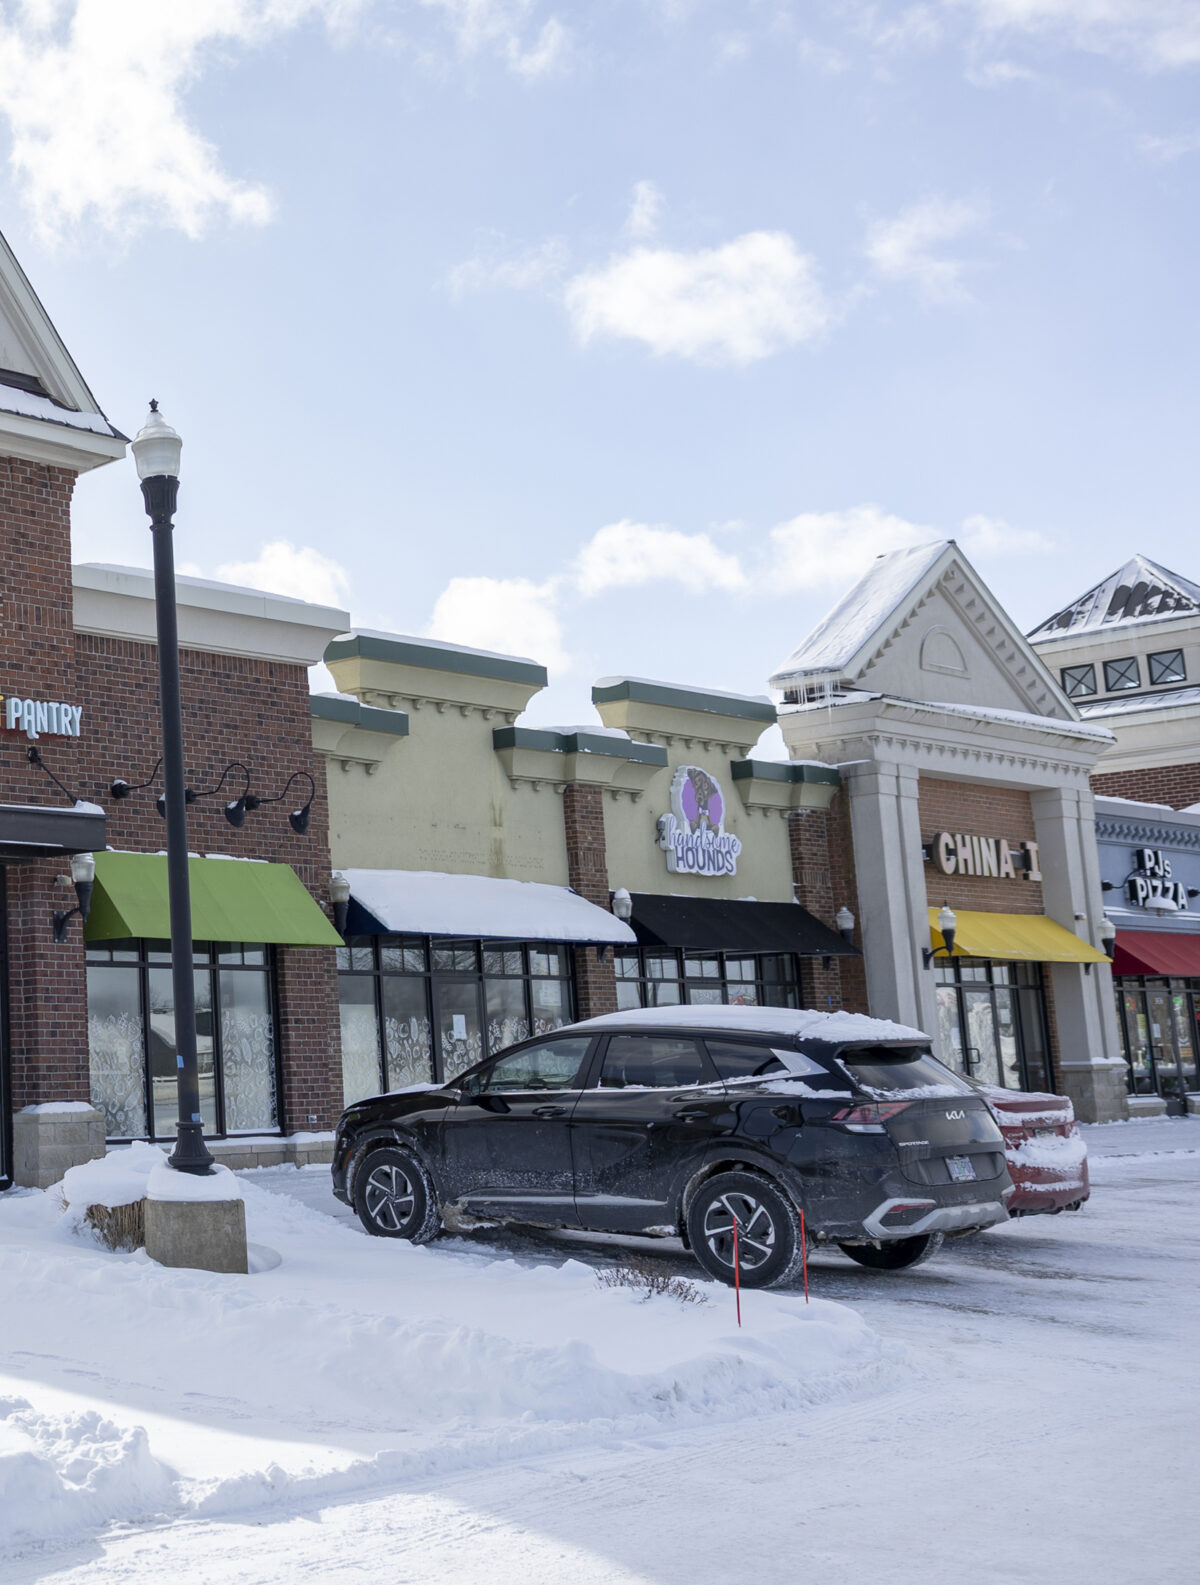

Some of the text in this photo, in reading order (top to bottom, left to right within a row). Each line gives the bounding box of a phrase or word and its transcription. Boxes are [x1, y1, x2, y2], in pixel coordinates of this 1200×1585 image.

[6, 697, 83, 740] PANTRY
[668, 816, 740, 854] handsome
[675, 846, 734, 873] HOUNDS
[937, 831, 1016, 879] CHINA
[1132, 876, 1188, 910] PIZZA
[945, 1109, 966, 1121] KIA
